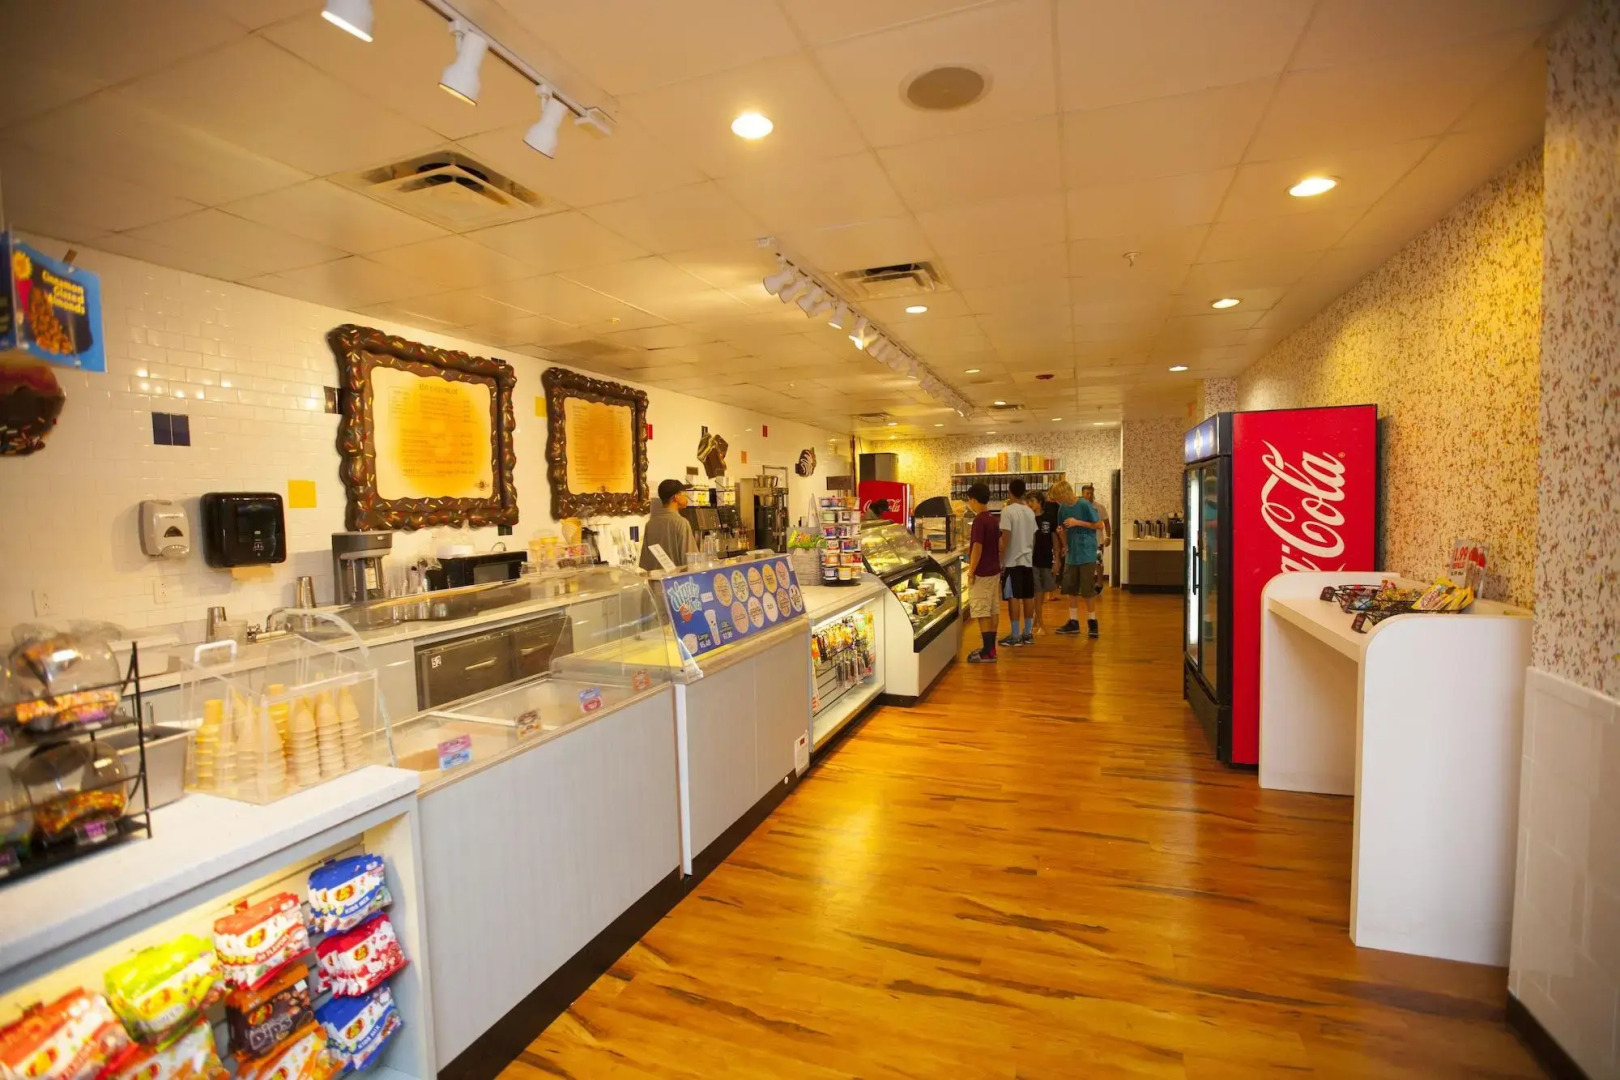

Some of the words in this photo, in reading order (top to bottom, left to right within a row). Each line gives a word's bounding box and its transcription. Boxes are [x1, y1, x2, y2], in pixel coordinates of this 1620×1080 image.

[42, 269, 84, 295] Cinnamon
[53, 285, 85, 304] Glazed
[1261, 440, 1347, 572] -Cola
[432, 657, 441, 668] 52
[345, 904, 359, 915] KIDS
[358, 896, 370, 906] MIX
[358, 1035, 372, 1050] KIDS
[369, 1025, 381, 1040] MIX
